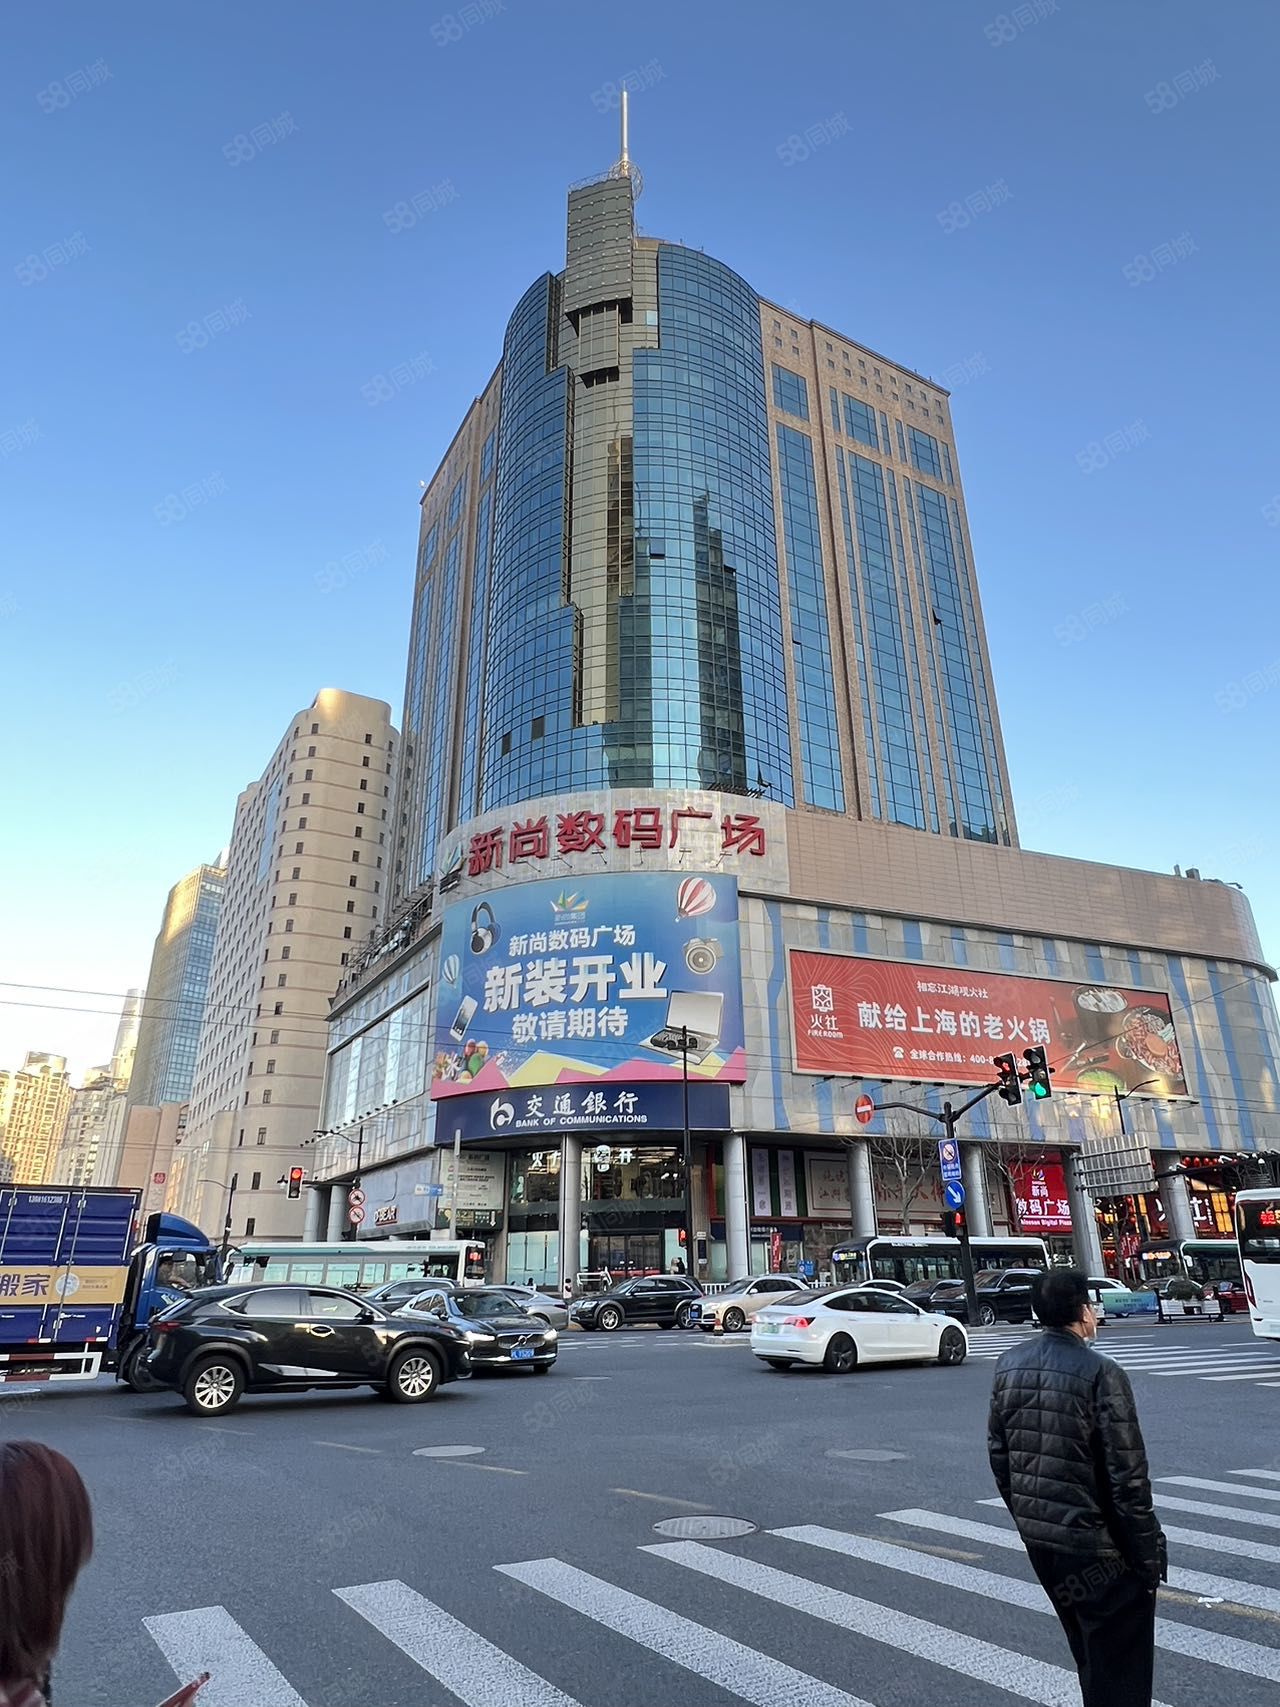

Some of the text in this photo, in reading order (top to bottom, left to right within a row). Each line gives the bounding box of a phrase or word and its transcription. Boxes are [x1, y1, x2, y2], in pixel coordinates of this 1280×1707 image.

[468, 806, 767, 876] 新尚数码广场
[509, 924, 636, 957] 新尚数码广场
[483, 952, 668, 1013] 新装开业
[512, 1006, 628, 1042] 敬请期待
[810, 1014, 839, 1031] 火社
[857, 1001, 1051, 1045] 献给上海的老火锅
[515, 1113, 648, 1128] BANK OF COMMUNICATIONS
[525, 1090, 639, 1117] 交通銀行
